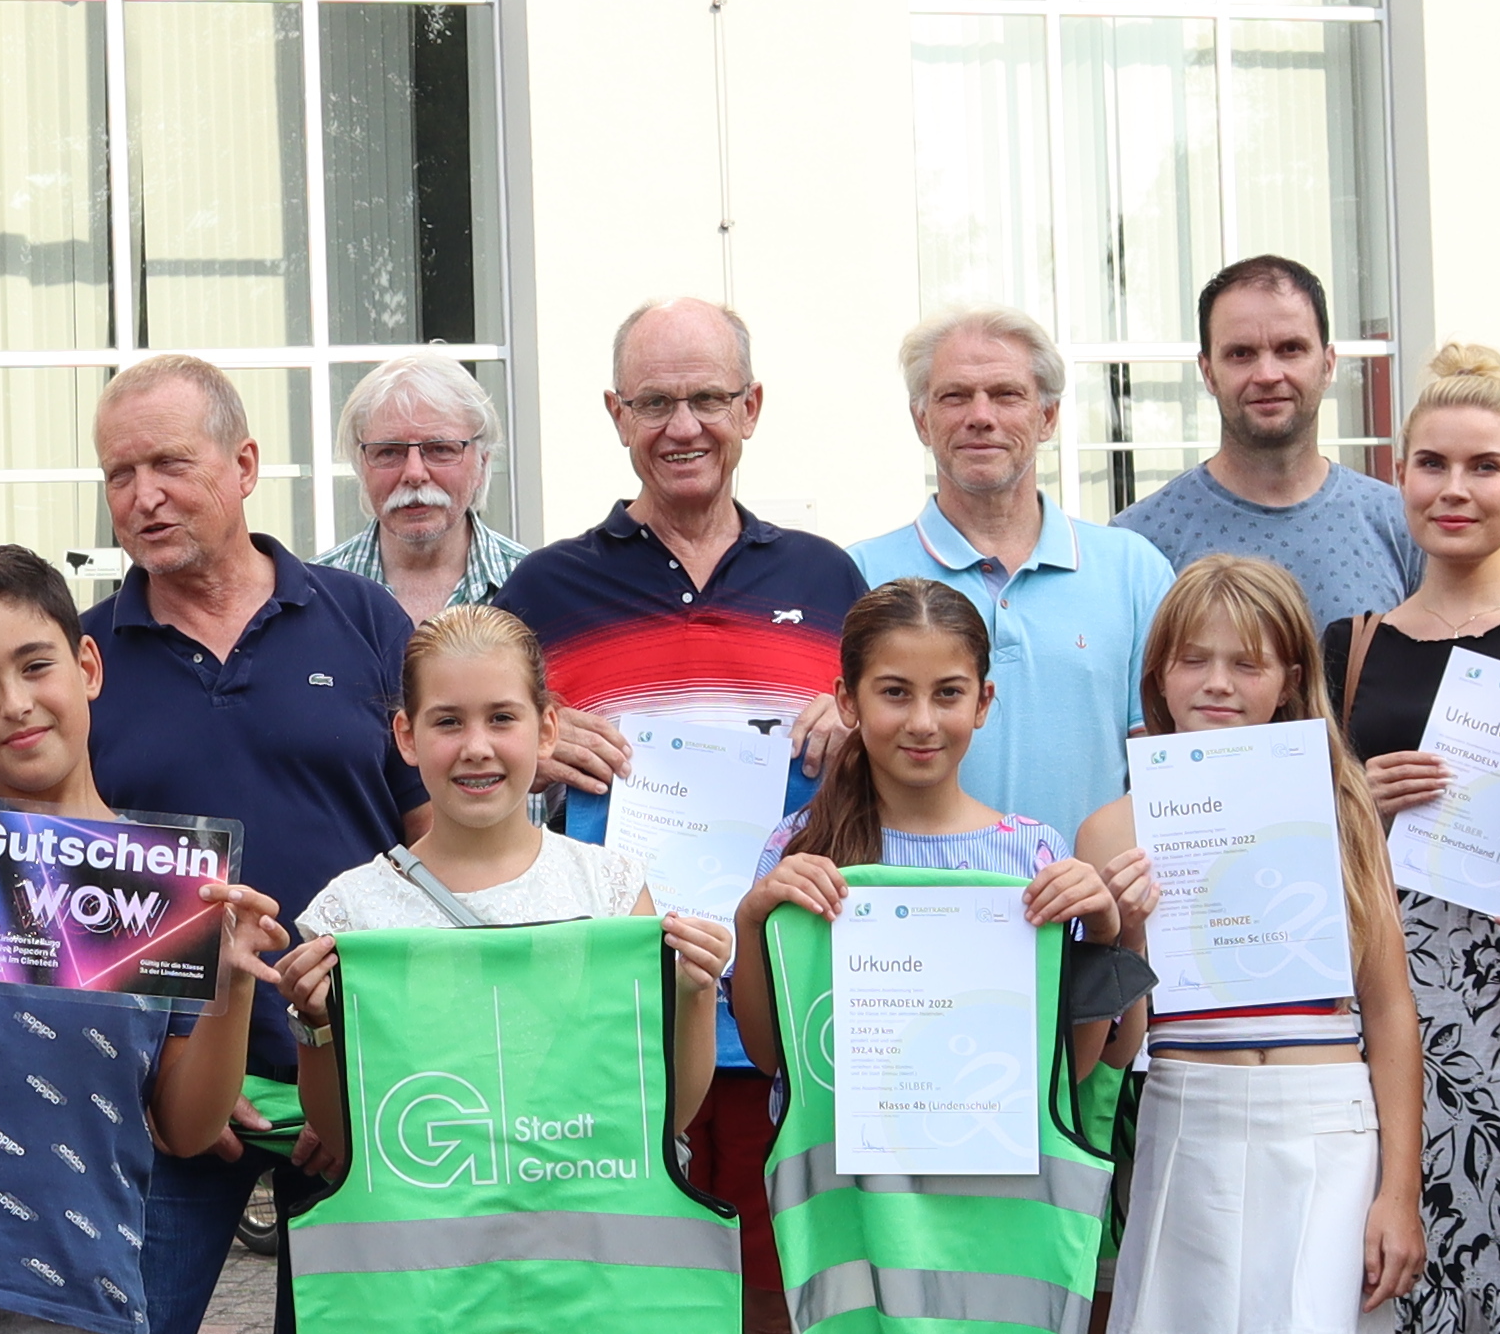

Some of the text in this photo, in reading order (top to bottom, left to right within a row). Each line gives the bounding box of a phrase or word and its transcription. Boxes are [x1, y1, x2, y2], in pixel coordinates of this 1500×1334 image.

[1435, 741, 1500, 768] STADTRADELN
[625, 774, 688, 797] Urkunde
[1149, 796, 1223, 818] Urkunde
[621, 806, 684, 828] STADTRADELN
[687, 821, 709, 832] 2022
[1154, 835, 1256, 853] STADTRADELN 2022
[1407, 824, 1495, 858] Urenco Deutschland
[654, 898, 689, 914] therapie
[1209, 915, 1251, 927] BRONZE
[1214, 936, 1245, 946] Klasse
[1261, 931, 1288, 944] (EGS)
[13, 946, 48, 957] Popcorn
[849, 955, 923, 972] Urkunde
[850, 998, 953, 1009] STADTRADELN 2022
[22, 1012, 57, 1039] adidas
[881, 1027, 894, 1035] km
[89, 1028, 118, 1059] adidas
[899, 1082, 933, 1091] SILBER
[879, 1100, 1001, 1112] Klasse 4b (Lindenschule)
[514, 1113, 595, 1142] Stadt
[58, 1143, 87, 1173] adidas
[518, 1157, 637, 1183] Gronau
[30, 1258, 65, 1288] adidas
